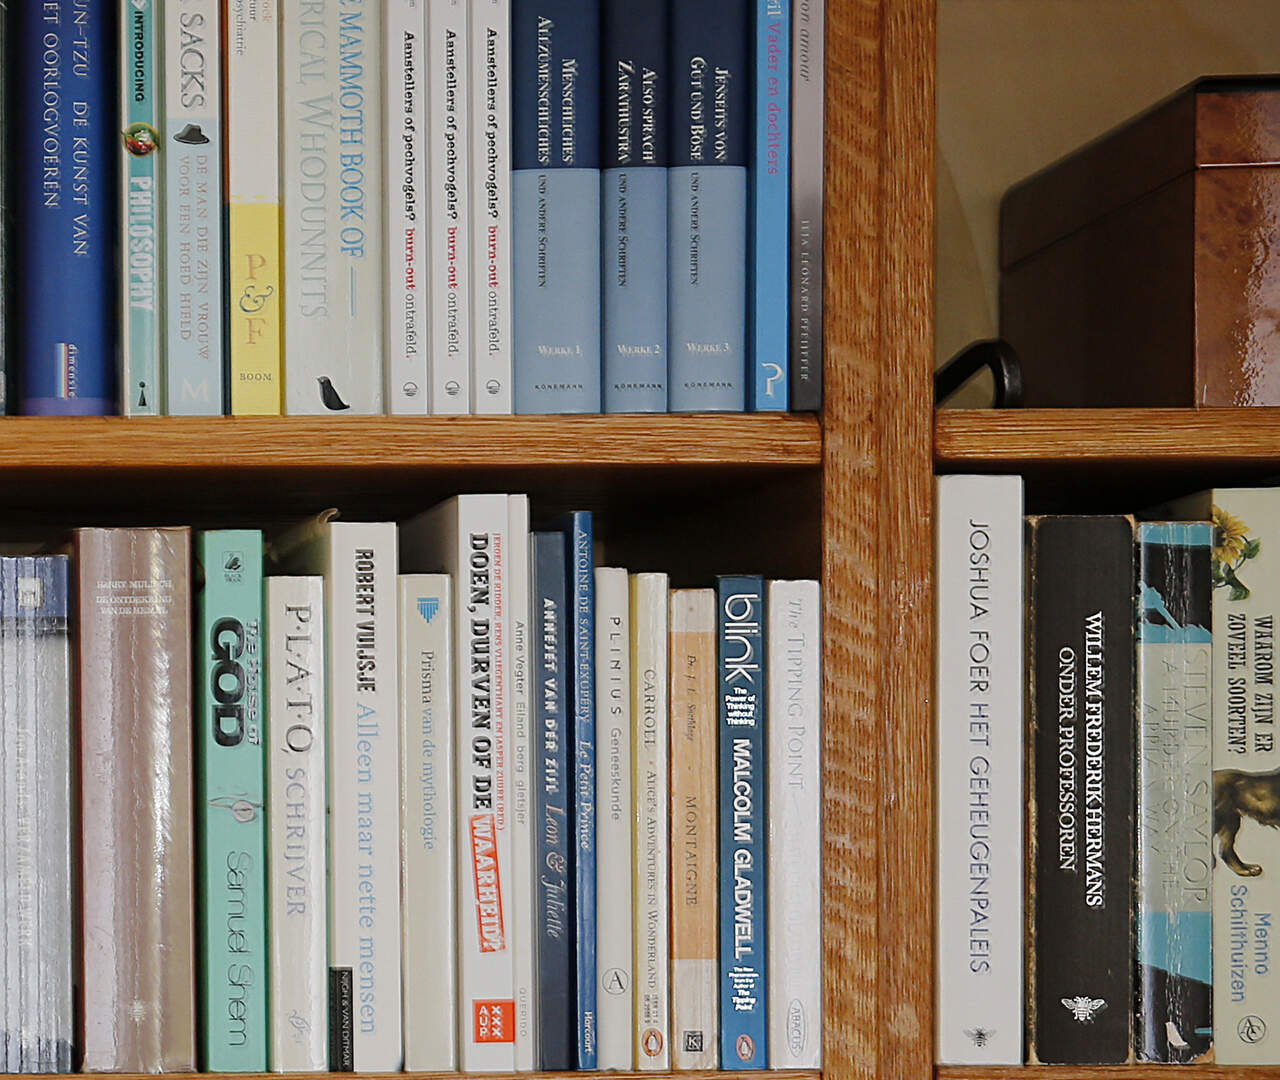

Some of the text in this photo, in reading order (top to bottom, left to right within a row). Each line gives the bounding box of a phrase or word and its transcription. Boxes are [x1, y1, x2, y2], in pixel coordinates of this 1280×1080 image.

[42, 33, 59, 209] OORLOGVOEREN
[180, 13, 204, 109] SACKS
[403, 31, 416, 113] Aanstellers
[404, 118, 417, 132] of
[767, 23, 781, 175] Vader en dochters
[72, 102, 88, 257] DE KUNST VAN
[339, 12, 366, 258] MAMMOTH BOOK OF
[400, 134, 417, 221] pechvogels?
[404, 228, 417, 290] burn-out
[209, 617, 244, 747] GOD
[470, 619, 491, 729] DURVEN
[725, 593, 758, 682] blink
[1228, 614, 1247, 754] ZOVEEL SOORTEN?
[1253, 615, 1273, 753] WAAROM ZIJN ER
[354, 549, 377, 1034] ROBERT VUIJSJE Alleen maar nette mensen
[418, 650, 438, 850] Prisma van de mythologie
[471, 736, 492, 770] OF
[472, 776, 492, 809] DE
[733, 738, 752, 841] MALCOLM
[969, 519, 990, 973] JOSHUA FOER HET GEHEUGENPALEIS
[1058, 647, 1076, 871] ONDER PROFESSOREN
[1085, 613, 1104, 906] WILLEM FREDERIK HERMANS
[225, 850, 252, 1047] Samuel Shem
[470, 817, 503, 952] WAARHEID?
[733, 849, 753, 959] GLADWELL
[1230, 884, 1249, 1002] Schilthuizen
[1254, 913, 1270, 975] Menno
